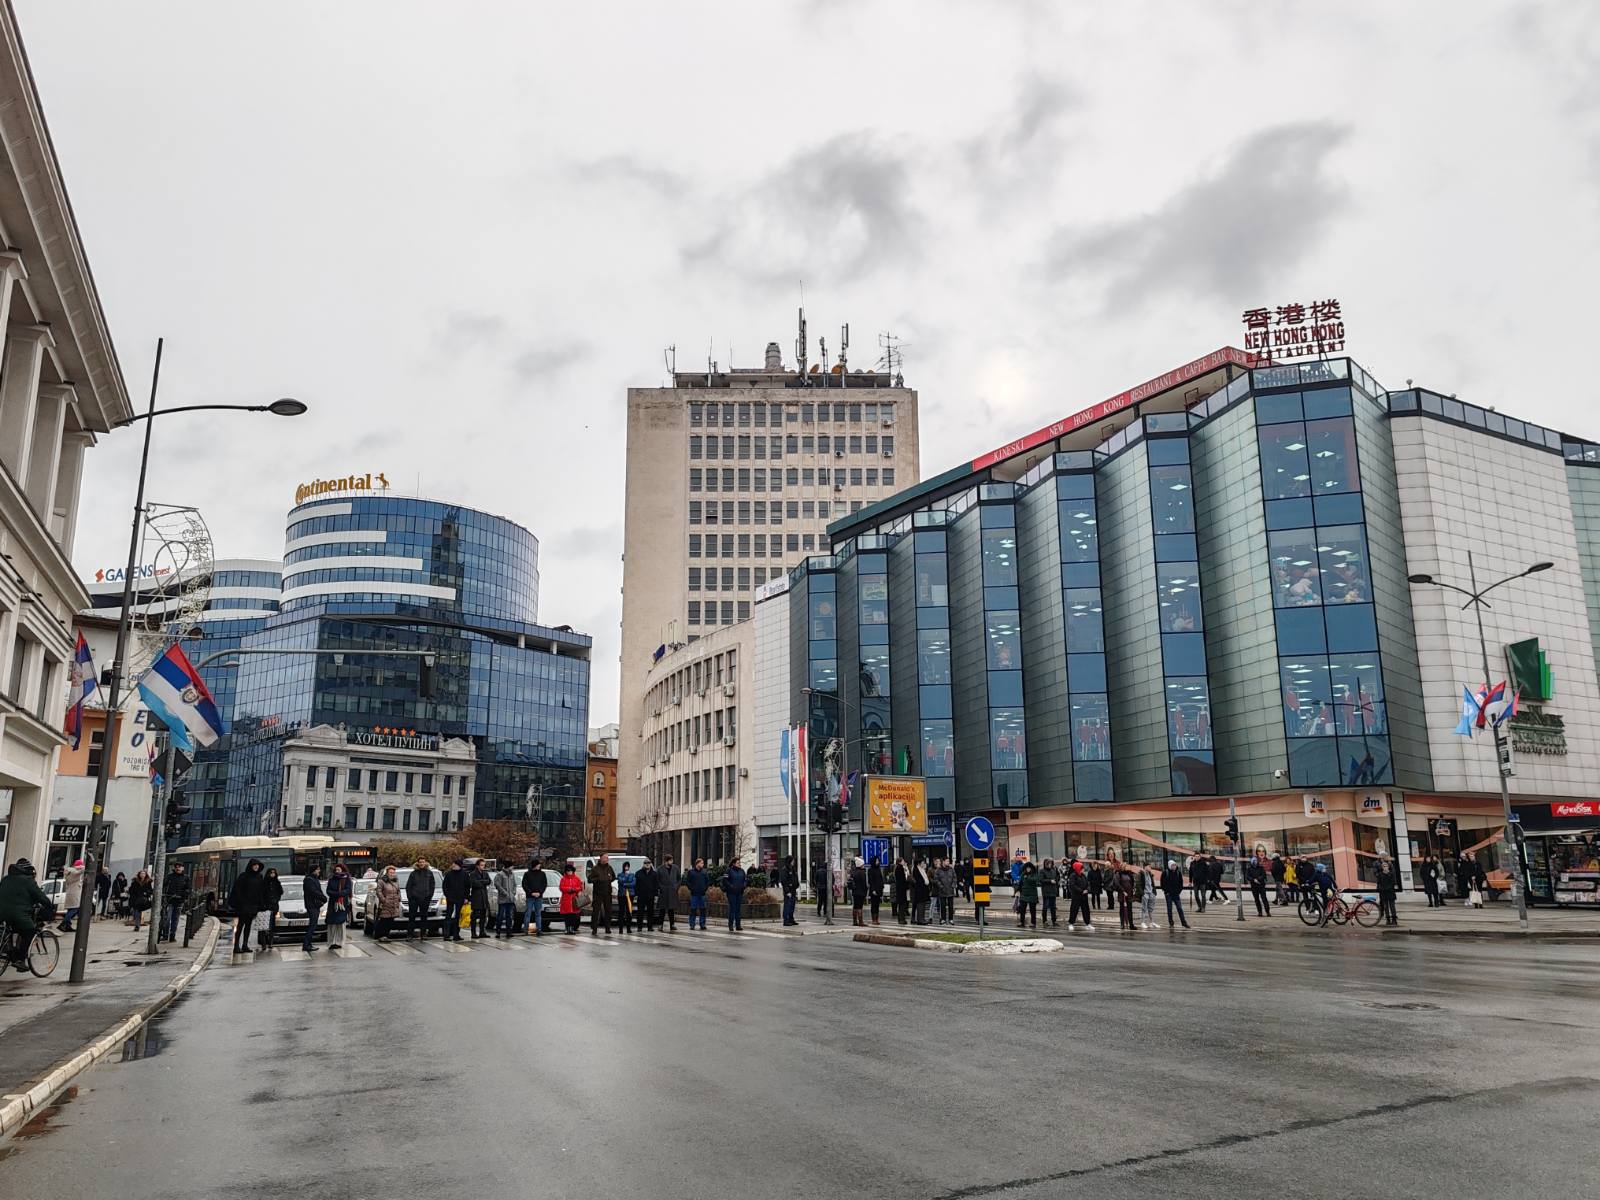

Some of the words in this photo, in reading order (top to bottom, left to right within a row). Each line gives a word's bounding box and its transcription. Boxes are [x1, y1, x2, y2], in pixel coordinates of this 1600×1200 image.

[1244, 331, 1270, 350] NEW
[1273, 325, 1308, 346] HONG
[1311, 321, 1345, 343] KONG
[1246, 340, 1346, 363] RESTAURANT
[993, 440, 1025, 462] KINESKI
[1050, 422, 1065, 436] NEW
[1073, 408, 1095, 427] HONG
[1103, 396, 1125, 415] KONG
[1130, 374, 1173, 401] RESTAURANT
[1184, 360, 1208, 377] CAFFE
[1211, 350, 1227, 366] BAR
[295, 473, 372, 505] Continental
[355, 732, 392, 747] ХОТЕЛ
[394, 736, 432, 750] ПУПИН
[878, 784, 916, 792] McDonald's
[1311, 797, 1323, 808] dm
[1363, 796, 1381, 808] dm
[59, 826, 80, 837] LEO
[1015, 847, 1026, 857] dm
